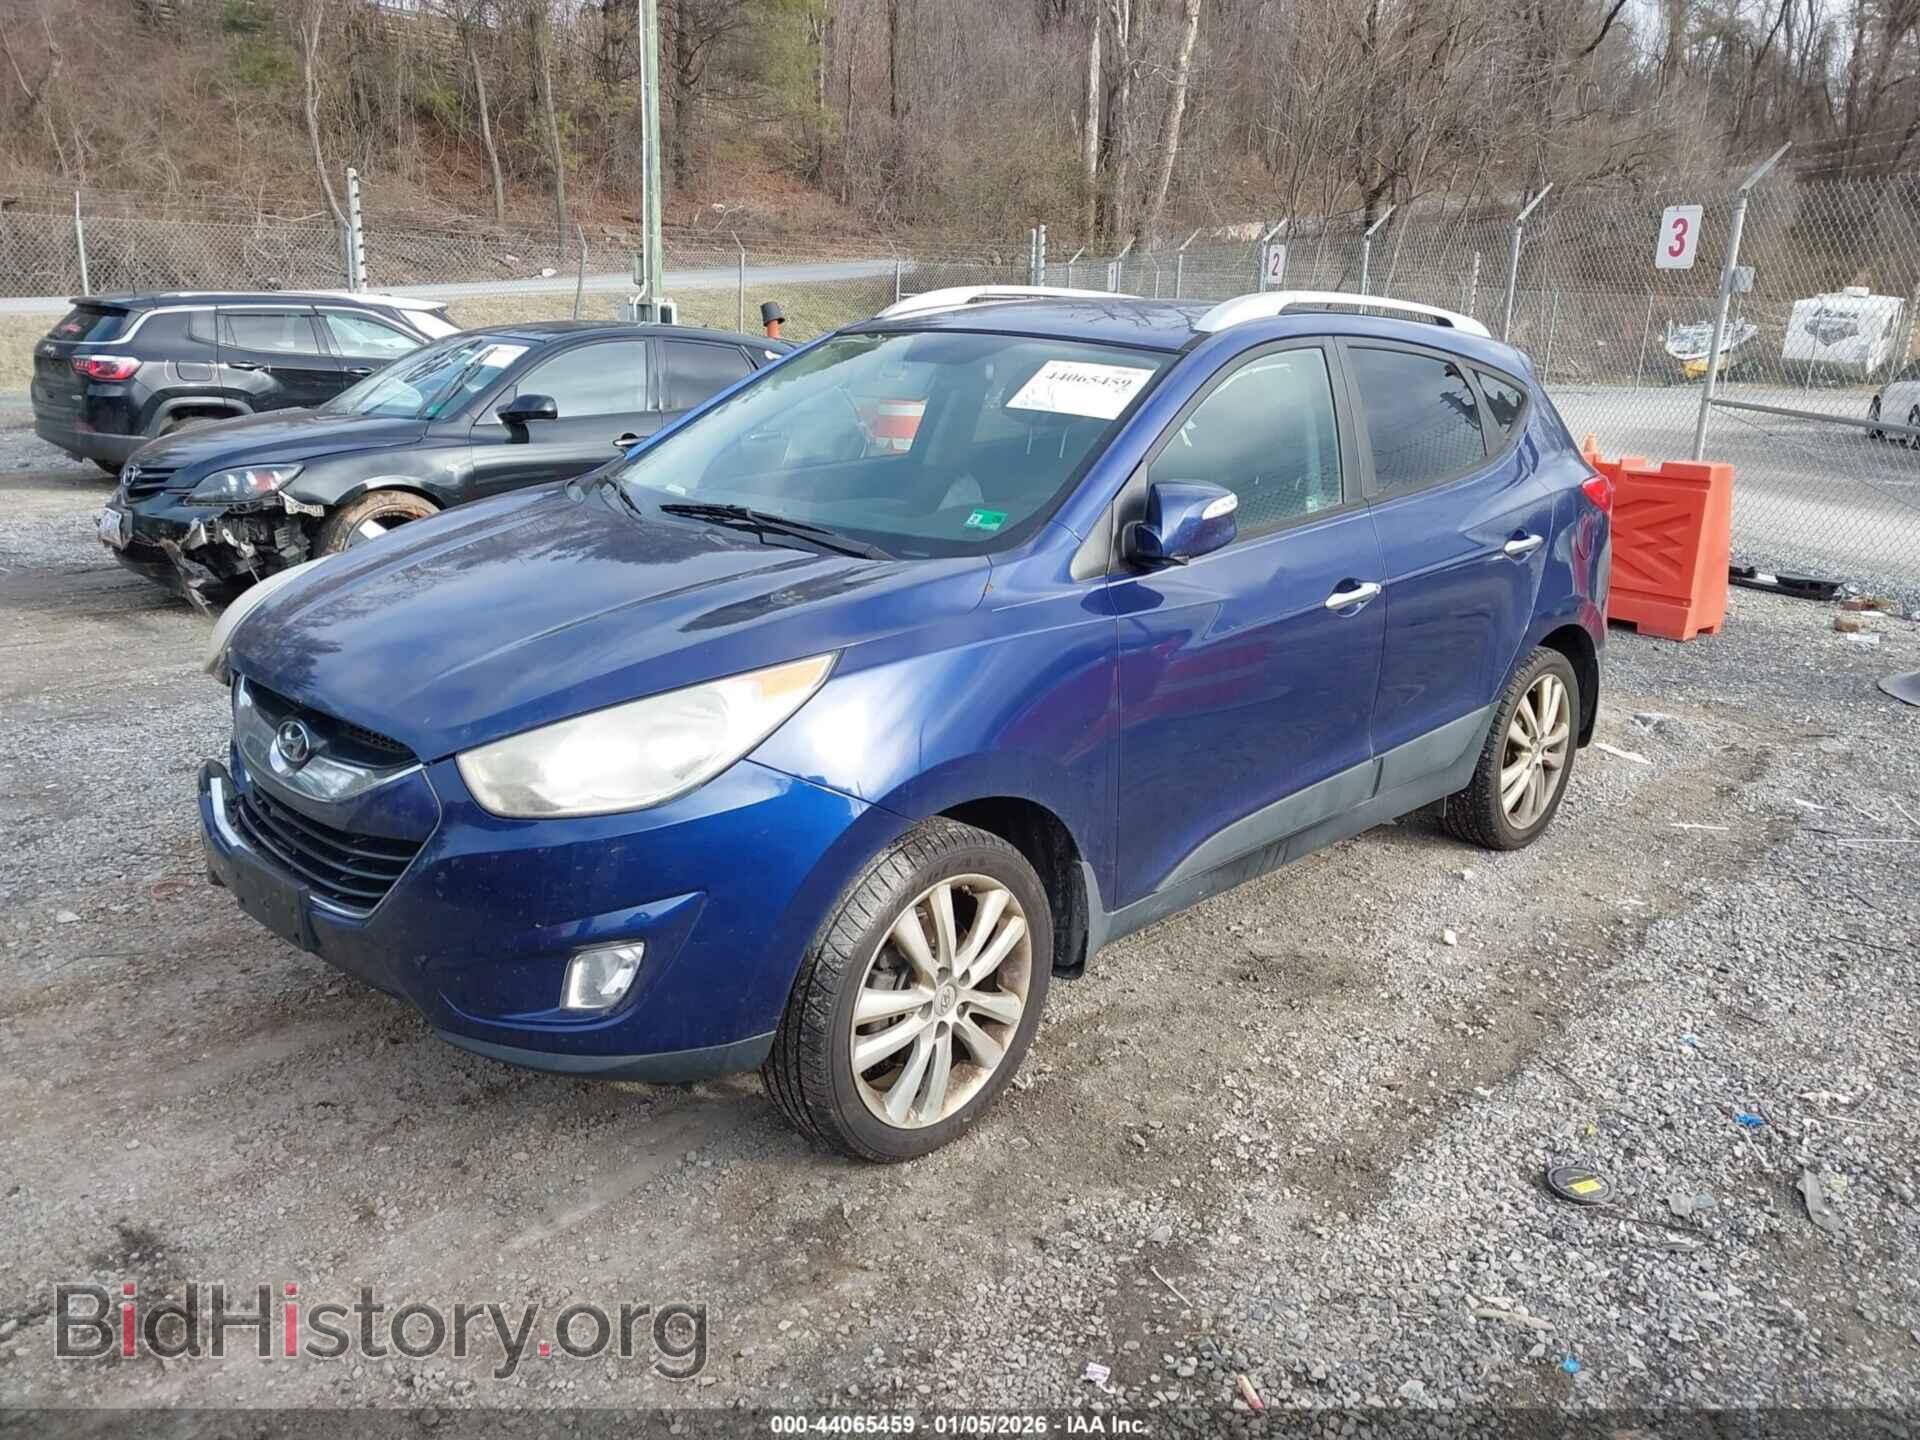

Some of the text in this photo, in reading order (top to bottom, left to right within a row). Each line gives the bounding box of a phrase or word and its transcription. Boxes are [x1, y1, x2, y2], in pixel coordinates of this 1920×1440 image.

[1668, 217, 1689, 258] 3
[1271, 252, 1281, 277] 2
[1045, 371, 1133, 387] 44065459
